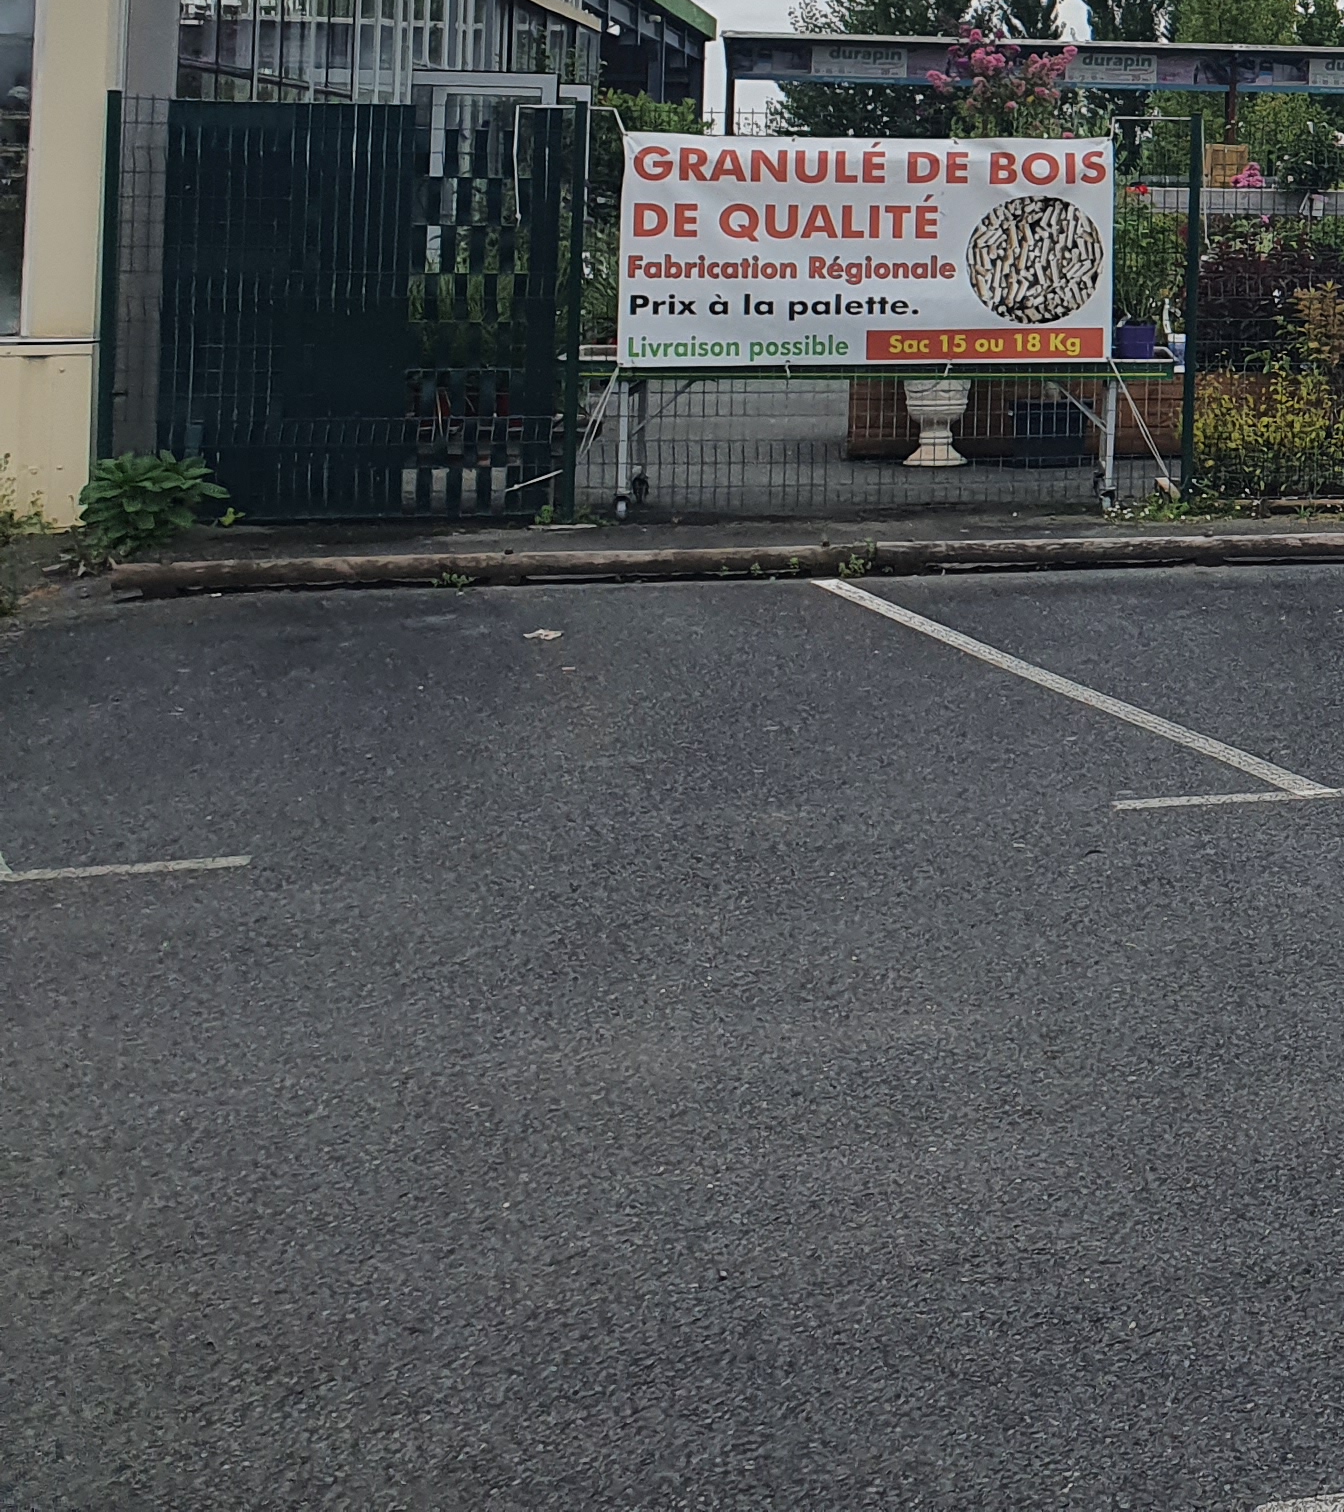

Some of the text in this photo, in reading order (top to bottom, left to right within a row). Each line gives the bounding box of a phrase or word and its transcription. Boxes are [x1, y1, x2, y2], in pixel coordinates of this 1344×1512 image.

[829, 46, 902, 63] durapin
[1082, 54, 1152, 71] durapin
[632, 142, 1106, 186] GRANULÉ DE BOIS
[633, 195, 939, 242] DE QUALITÉ
[627, 254, 956, 285] Fabrication Régionale
[629, 293, 920, 321] Prix à la palette.
[627, 334, 849, 362] Livraison possible
[889, 333, 1081, 355] Sac 15 ou 18 Kg
